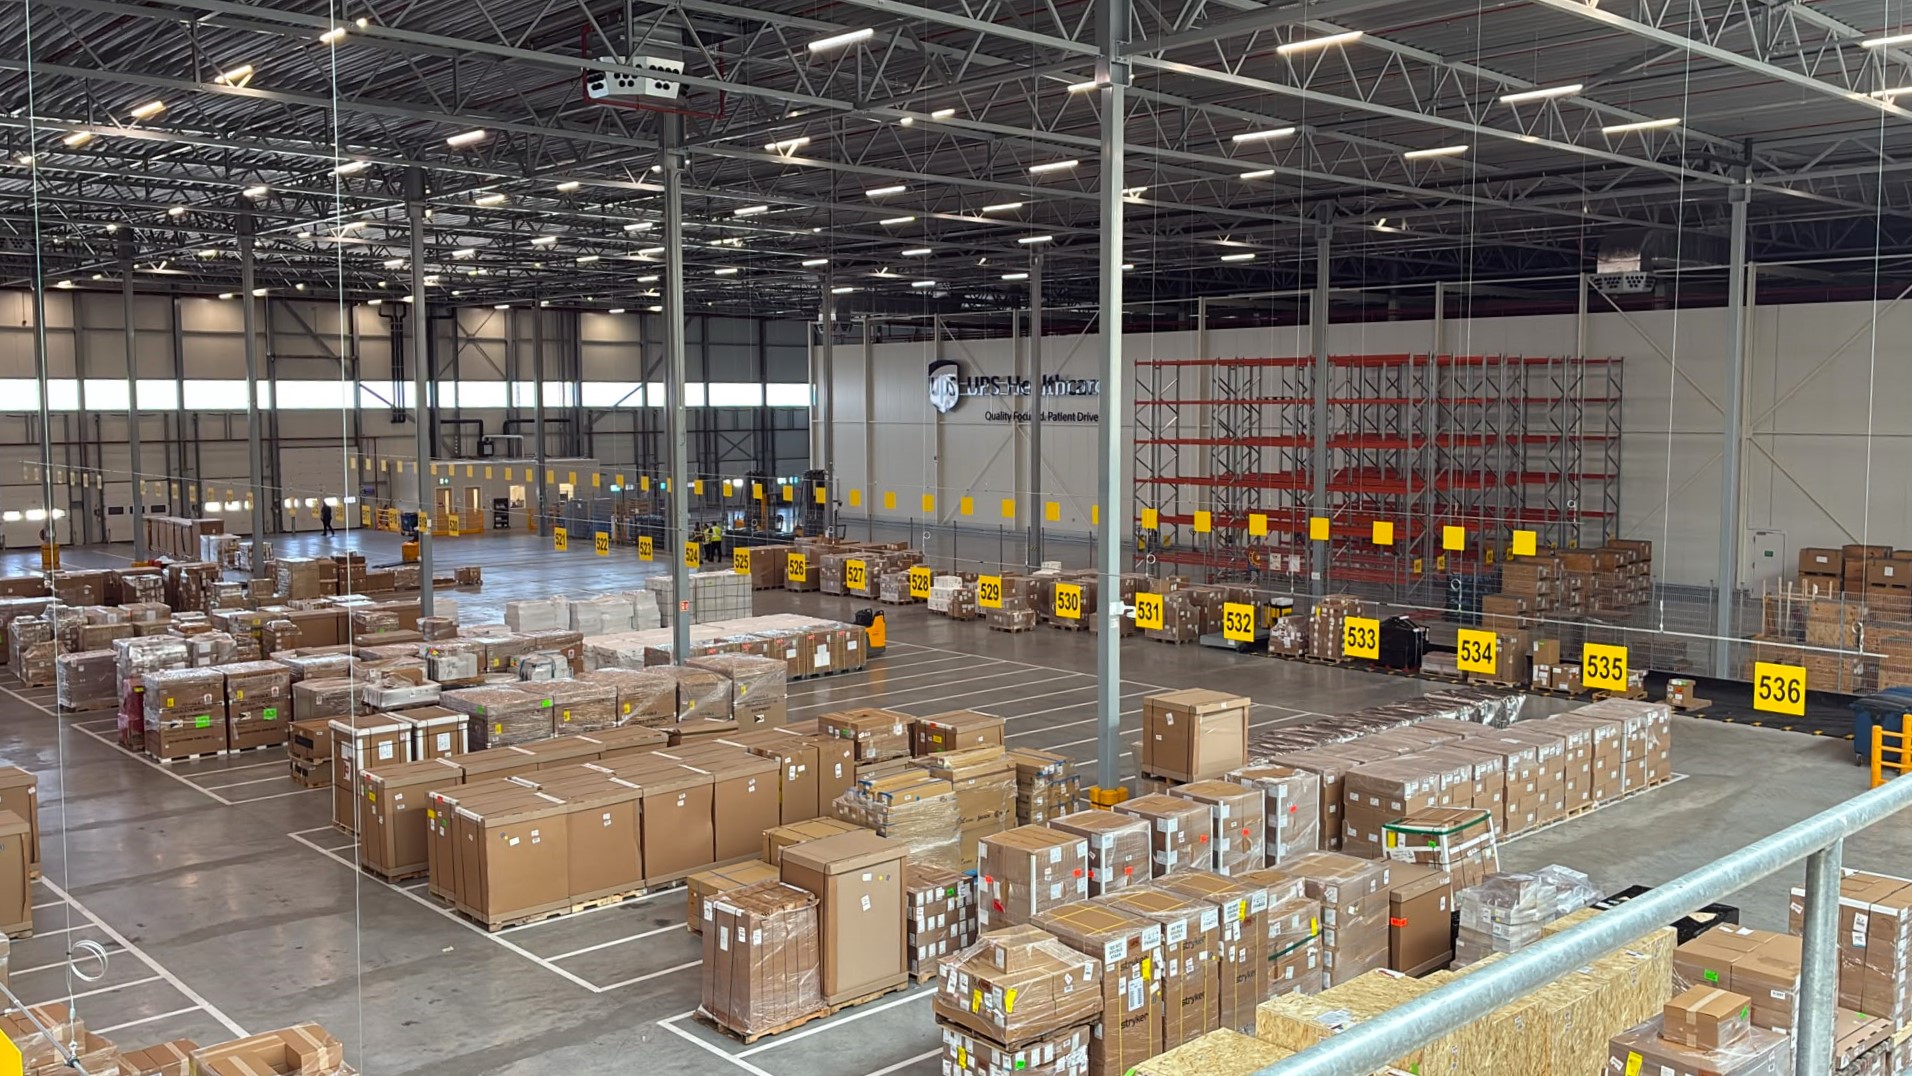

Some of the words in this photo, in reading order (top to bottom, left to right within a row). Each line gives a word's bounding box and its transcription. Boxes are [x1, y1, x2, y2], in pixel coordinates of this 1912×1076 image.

[967, 376, 1000, 396] UPS
[1007, 374, 1100, 396] Helthcar
[985, 411, 1012, 422] Quality
[1013, 411, 1046, 422] Focud.
[1047, 411, 1076, 422] Patient
[555, 532, 566, 548] 521
[597, 536, 607, 552] 522
[639, 541, 652, 557] 523
[685, 547, 699, 563] 524
[735, 553, 748, 569] 525
[789, 559, 805, 575] 526
[847, 567, 864, 583] 527
[911, 573, 930, 592] 528
[980, 582, 1001, 602] 529
[1058, 591, 1078, 611] 530
[1137, 600, 1160, 622] 531
[1226, 611, 1252, 634] 532
[1347, 626, 1376, 650] 533
[1461, 640, 1492, 664] 534
[1587, 654, 1624, 681] 535
[1757, 674, 1801, 705] 536
[1181, 991, 1206, 1007] stryker
[1121, 1012, 1149, 1029] stryker
